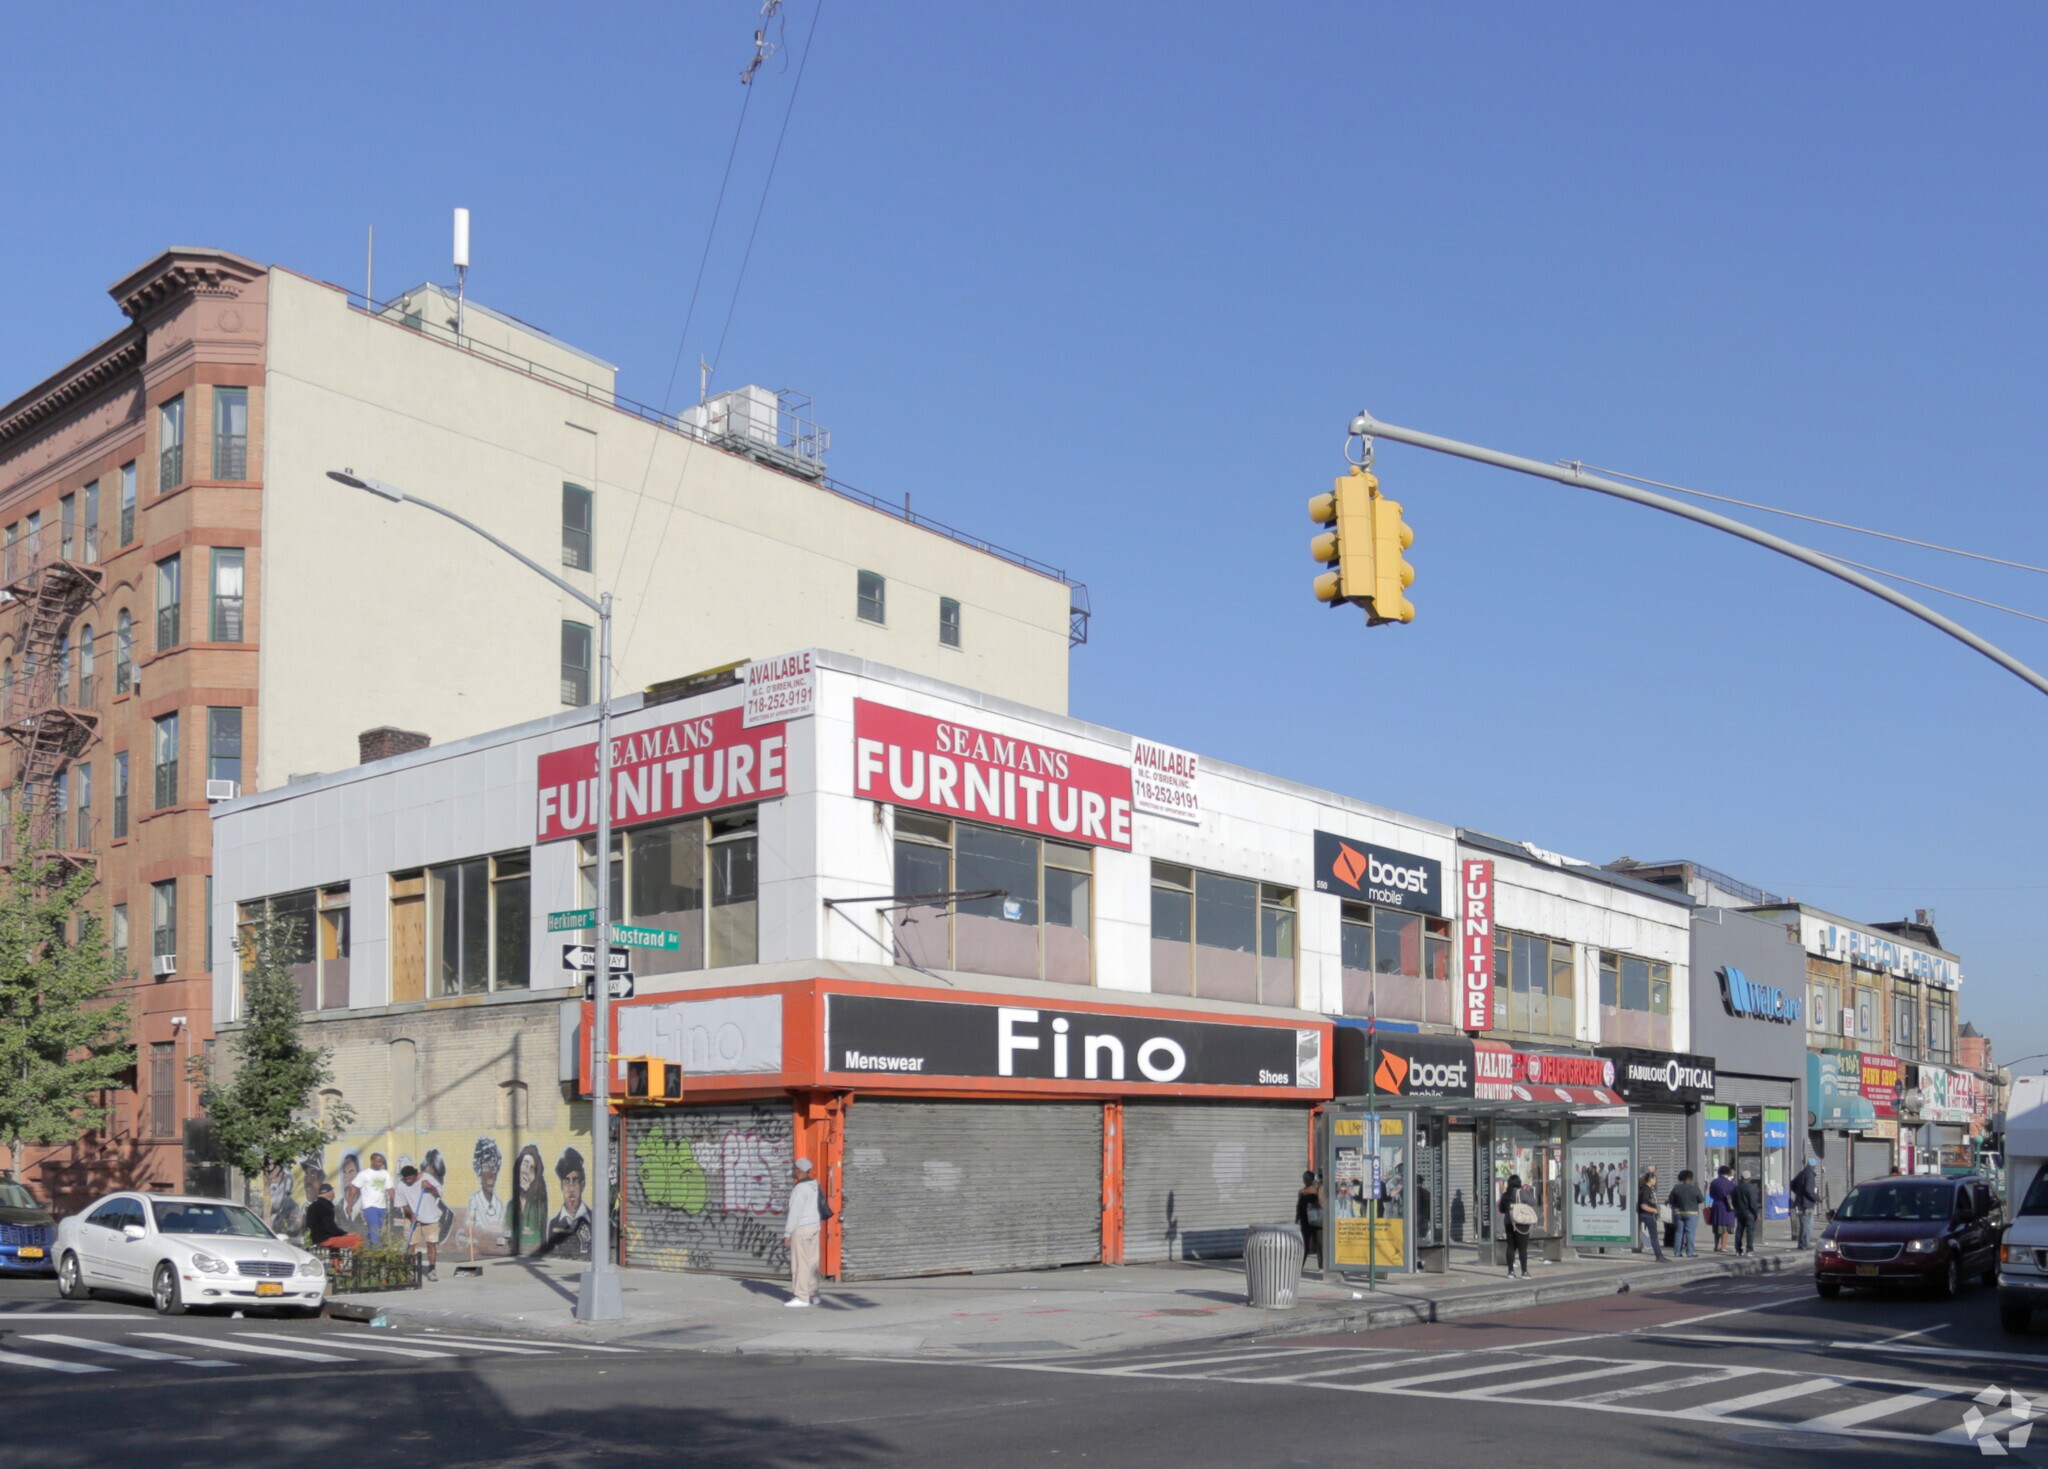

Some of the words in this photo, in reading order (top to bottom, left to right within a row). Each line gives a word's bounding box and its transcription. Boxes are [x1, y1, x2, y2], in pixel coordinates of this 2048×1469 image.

[748, 652, 811, 687] AVAILABLE
[748, 686, 812, 715] 718-252-9191
[936, 723, 1069, 780] SEAMANS
[1134, 743, 1196, 780] AVAILABLE
[857, 737, 1131, 845] FURNITURE
[1134, 780, 1198, 810] 718-252-9191
[1368, 853, 1428, 894] boost
[1368, 887, 1403, 905] mobile
[548, 912, 588, 931] Herkimer
[589, 911, 595, 921] St
[611, 927, 665, 947] Nostrand
[668, 933, 678, 943] Av
[1466, 863, 1489, 1027] FURNITURE
[582, 953, 595, 964] ON
[1849, 930, 1901, 970] FULTON
[1912, 950, 1955, 986] DENTAL
[650, 1007, 745, 1068] Fino
[997, 1007, 1187, 1083] Fino
[845, 1051, 924, 1072] Menswear
[1409, 1057, 1467, 1088] boost
[1475, 1051, 1513, 1079] VALUE
[1542, 1056, 1560, 1084] DELI
[1568, 1058, 1603, 1087] GROCERY
[1628, 1064, 1667, 1083] FABULOUS
[1666, 1060, 1714, 1092] OPTICAL
[1862, 1066, 1880, 1085] PAWN
[1881, 1069, 1897, 1087] SHOP
[1259, 1070, 1289, 1085] Shoes
[1946, 1072, 1974, 1096] PIZZA
